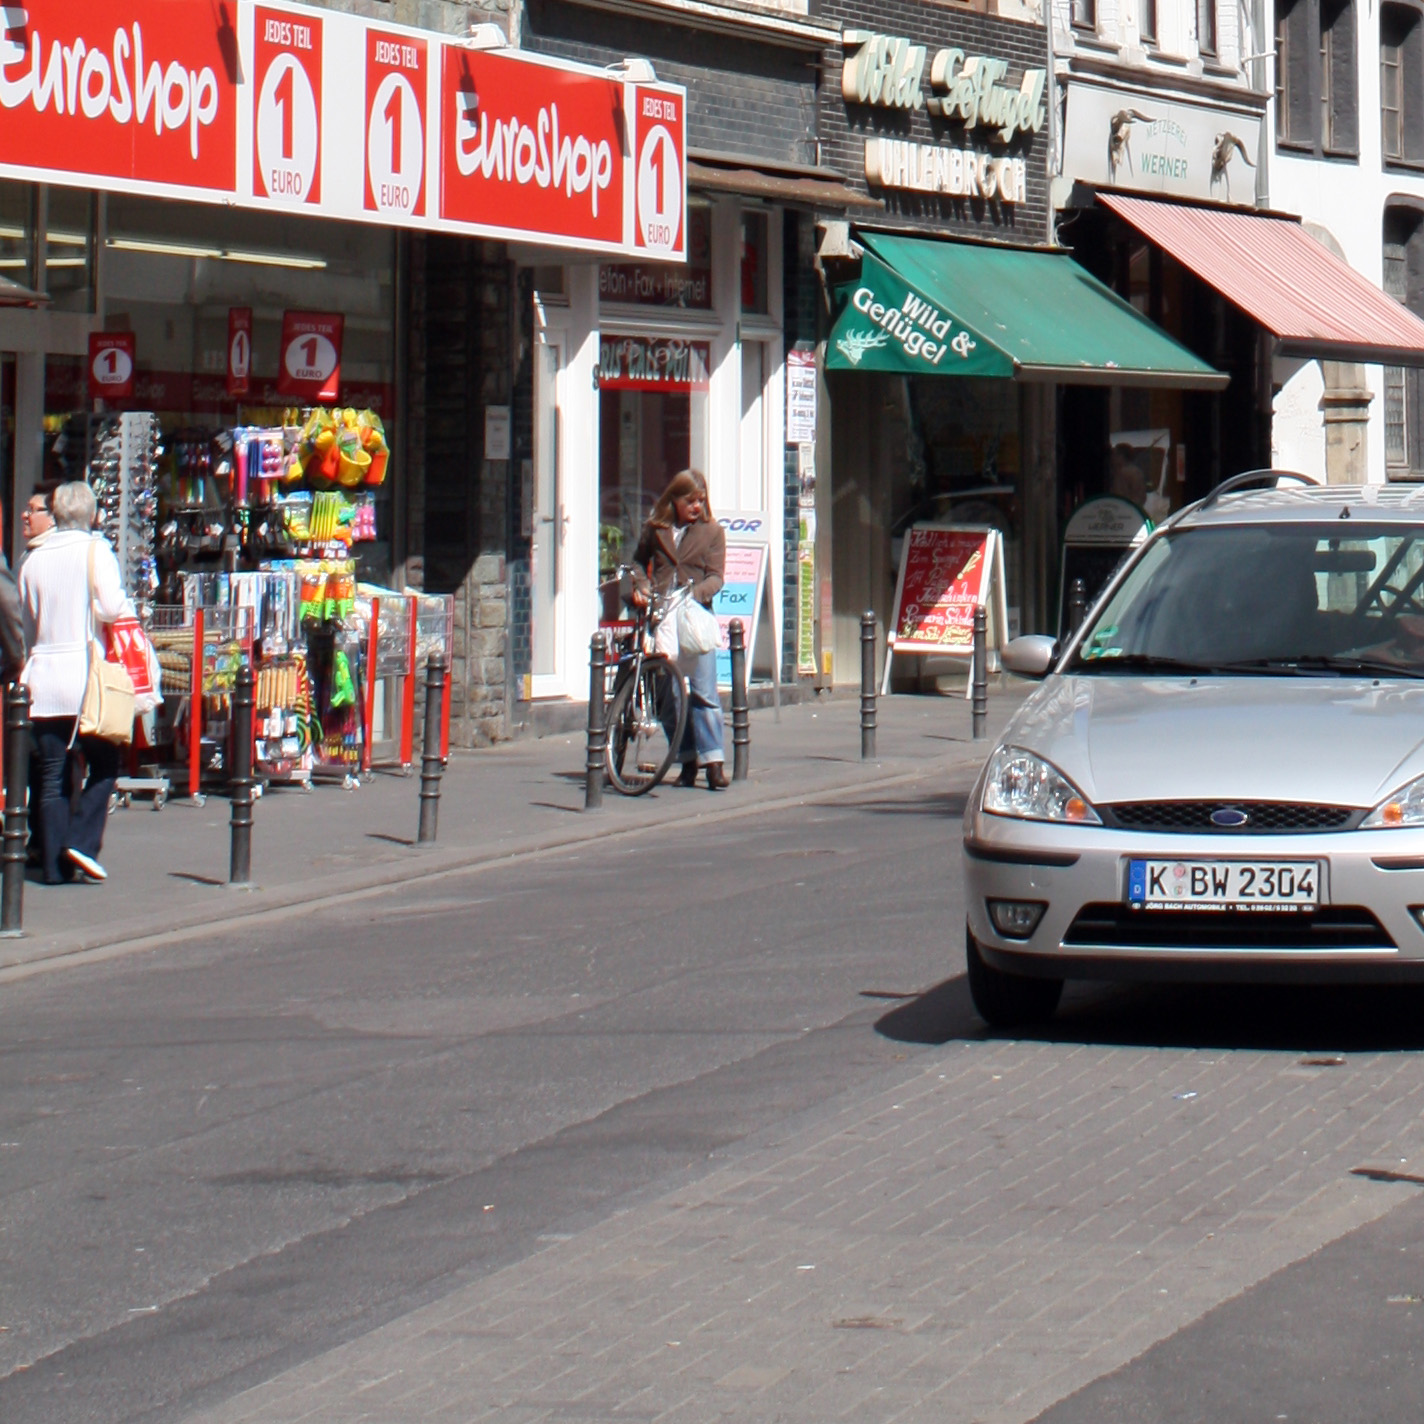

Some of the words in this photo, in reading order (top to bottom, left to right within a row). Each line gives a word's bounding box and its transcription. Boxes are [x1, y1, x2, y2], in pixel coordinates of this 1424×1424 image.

[264, 18, 292, 44] JEDES
[292, 25, 312, 49] TEIL
[375, 41, 400, 64] JEDES
[401, 46, 419, 70] TEIL
[842, 30, 927, 111] Wild
[0, 6, 218, 160] EuroShop
[273, 66, 294, 159] 1
[642, 96, 662, 118] JEDES
[662, 101, 677, 122] TEIL
[383, 85, 402, 175] 1
[456, 91, 612, 218] EuroShop
[1141, 153, 1188, 179] WERNER
[271, 169, 302, 196] EURO
[649, 136, 664, 215] 1
[381, 184, 410, 209] EURO
[648, 223, 671, 246] EURO
[634, 269, 656, 297] Fax
[664, 272, 706, 300] Internet
[852, 287, 947, 366] Geflügel
[901, 291, 953, 340] Wild
[951, 331, 977, 358] &
[102, 350, 118, 374] 1
[299, 337, 320, 367] 1
[101, 375, 122, 383] EURO
[295, 369, 322, 379] EURO
[717, 518, 762, 531] COR
[720, 590, 748, 603] Fax
[1149, 866, 1168, 896] K
[1191, 866, 1230, 897] BW
[1239, 867, 1314, 897] 2304
